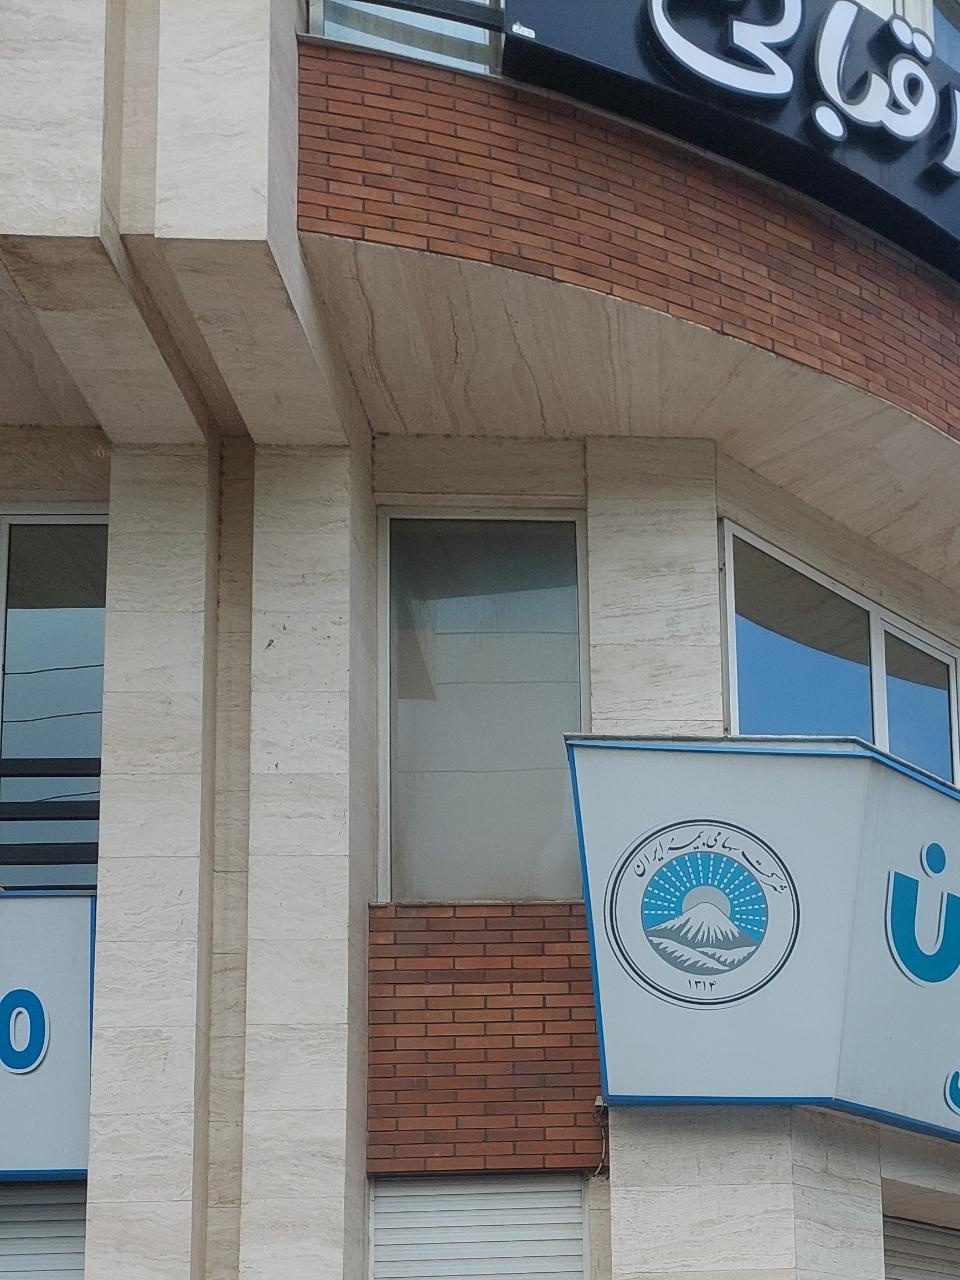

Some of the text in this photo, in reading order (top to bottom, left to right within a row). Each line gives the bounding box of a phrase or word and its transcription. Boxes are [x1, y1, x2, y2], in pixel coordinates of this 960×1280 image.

[706, 831, 740, 851] سهامی
[633, 840, 664, 877] ایران
[742, 850, 788, 894] شرکت
[688, 979, 717, 991] ۱۳۱۴
